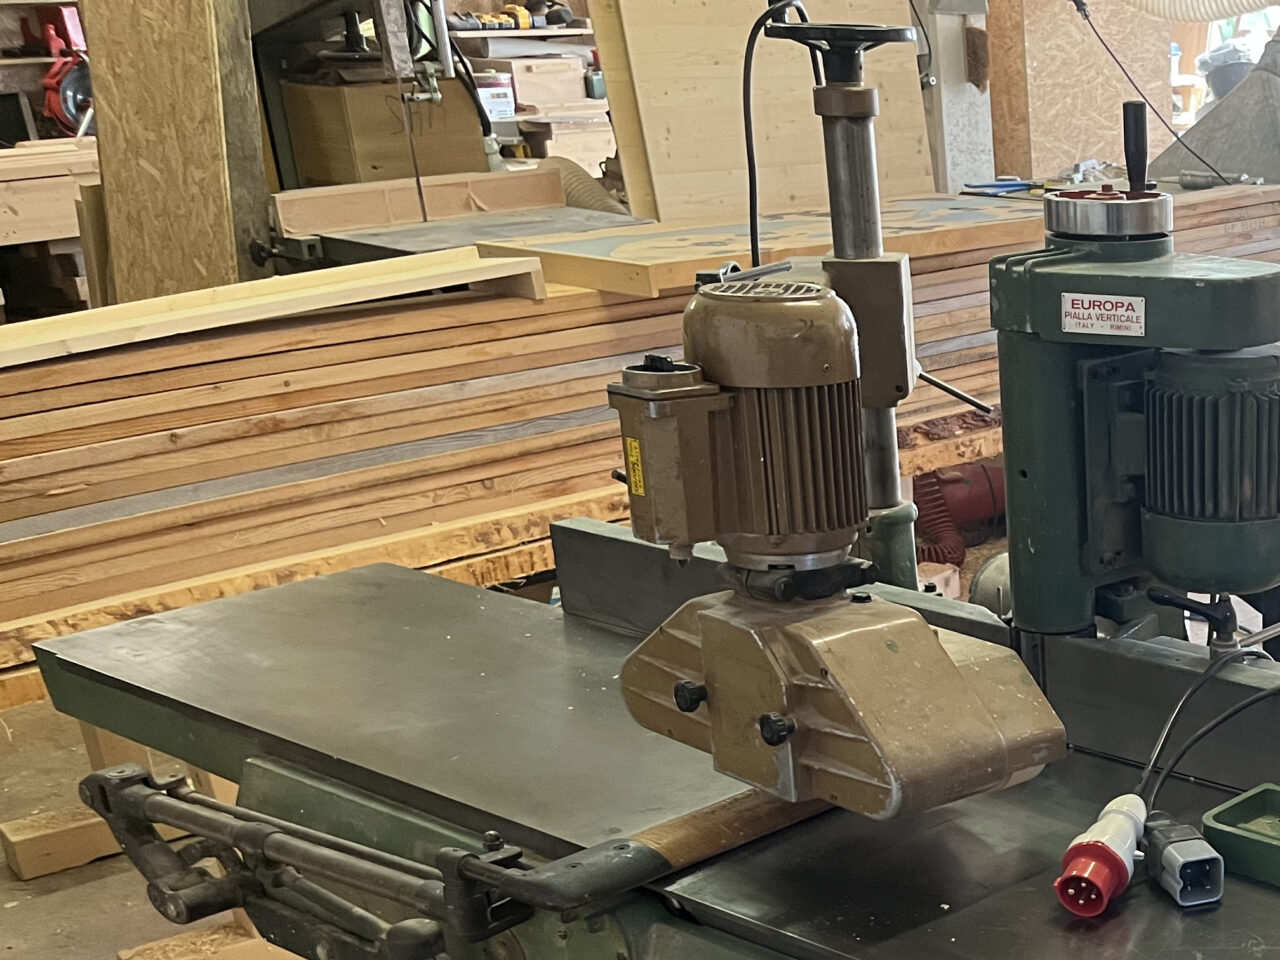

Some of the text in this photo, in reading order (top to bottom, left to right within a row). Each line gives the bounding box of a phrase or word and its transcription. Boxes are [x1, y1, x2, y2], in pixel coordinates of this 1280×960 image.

[1071, 298, 1136, 313] EUROPA
[1064, 311, 1142, 324] PIALLA VERTICALE
